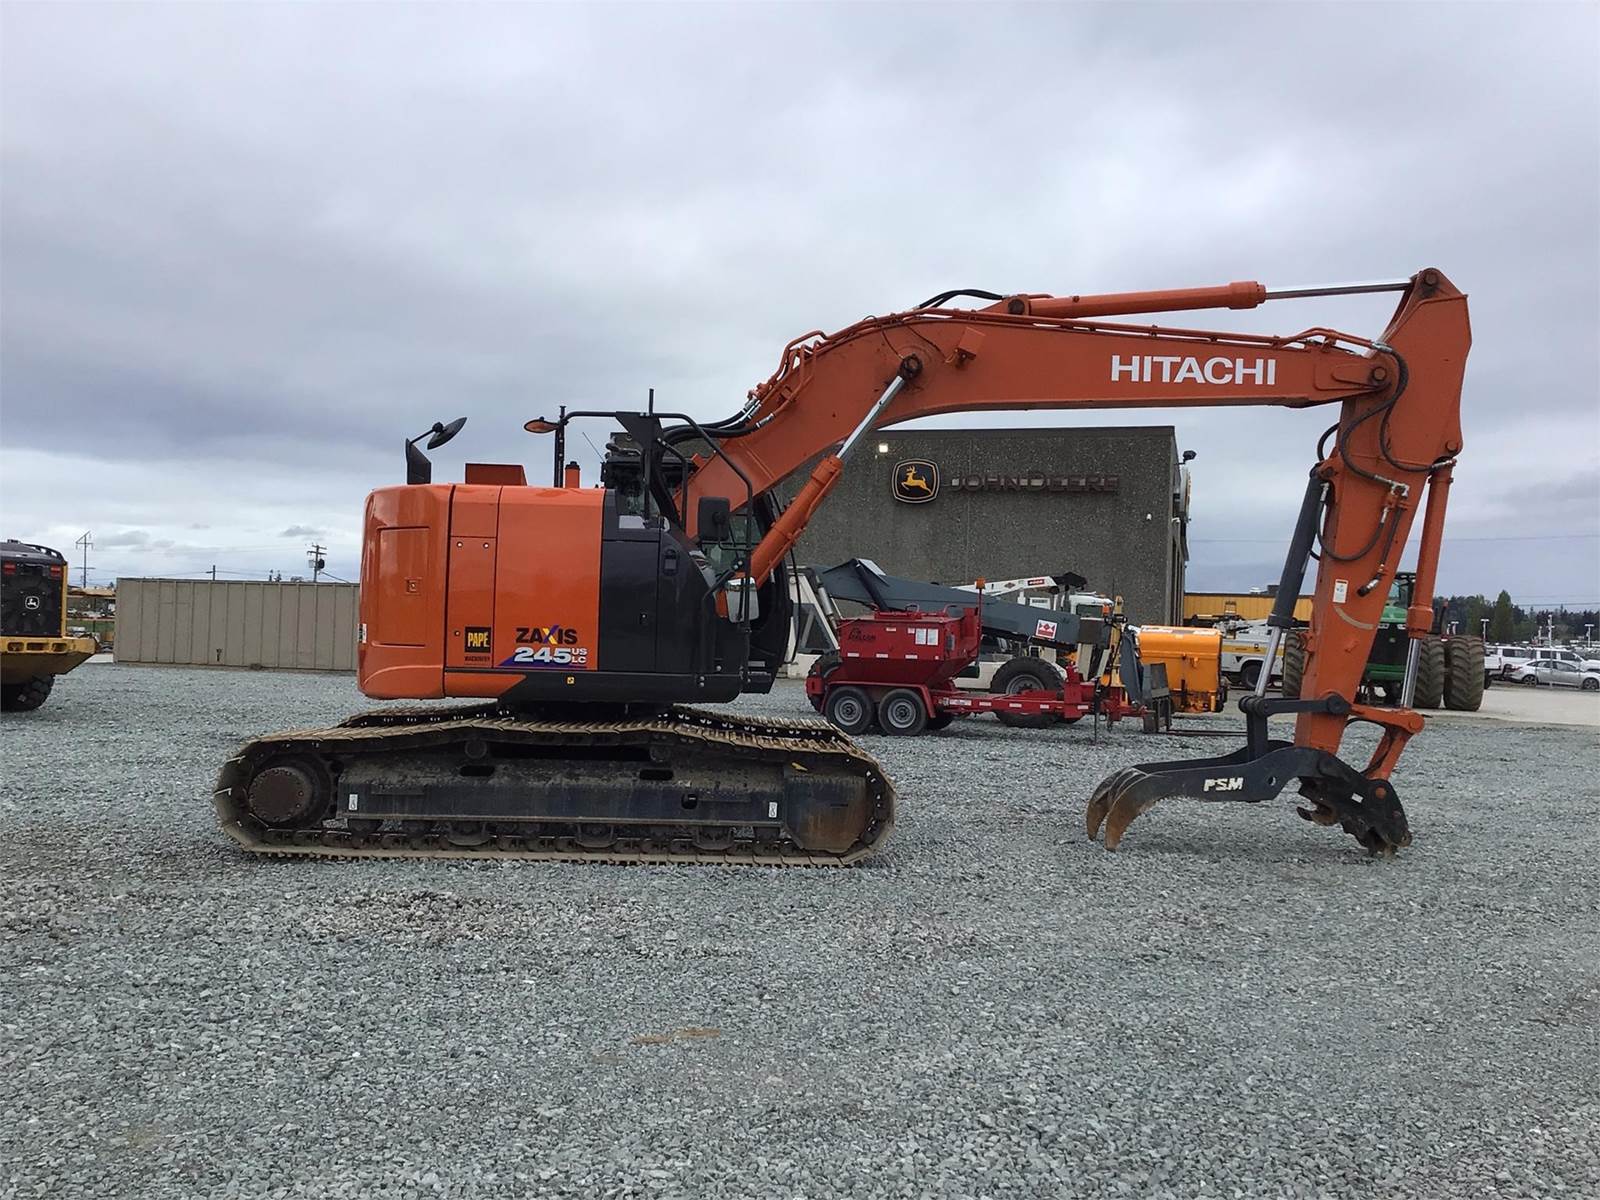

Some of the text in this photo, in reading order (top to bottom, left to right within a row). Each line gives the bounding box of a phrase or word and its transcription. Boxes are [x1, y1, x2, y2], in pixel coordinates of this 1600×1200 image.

[1111, 354, 1276, 385] HITACHI
[951, 471, 1119, 492] JOHN DEERE
[515, 624, 578, 645] ZAXIS
[513, 646, 588, 664] 245 US
[571, 655, 587, 664] LC
[1203, 777, 1244, 792] PSM
